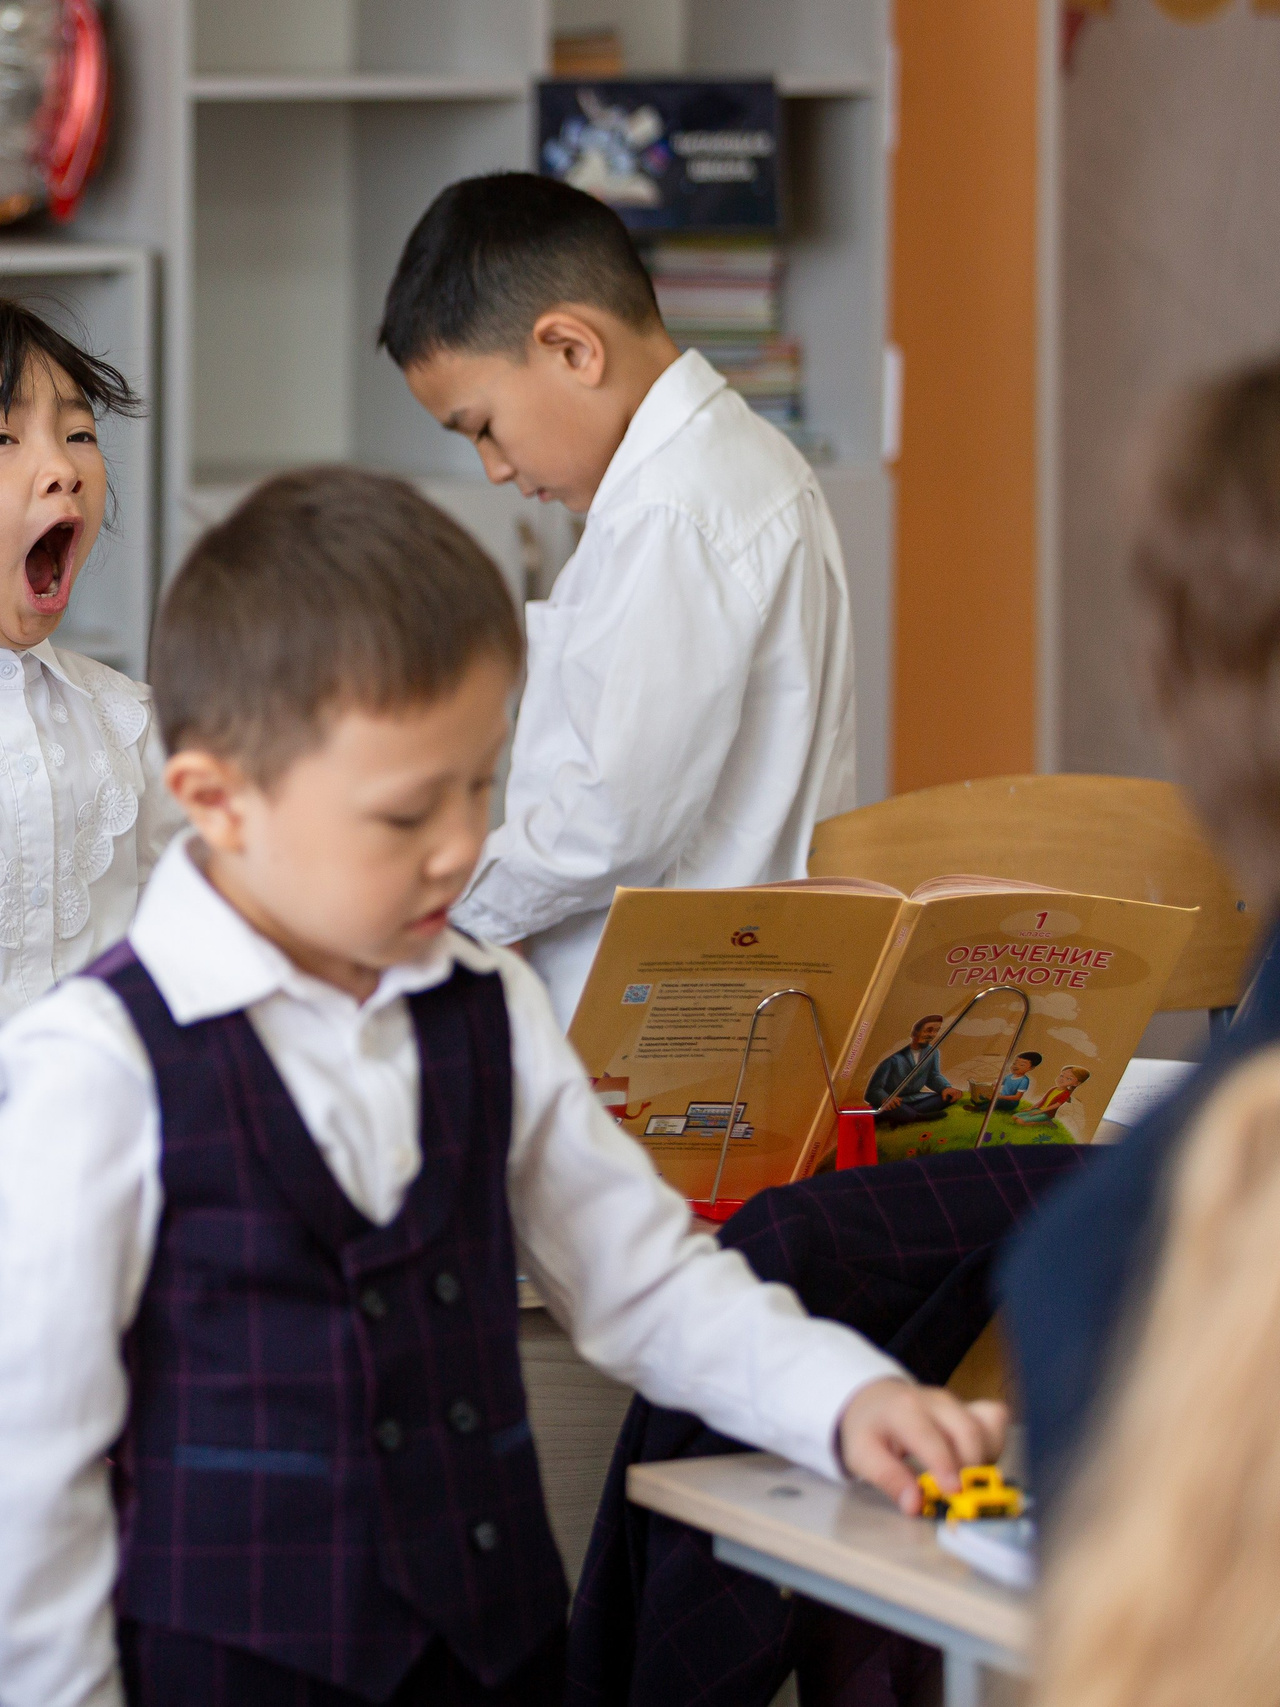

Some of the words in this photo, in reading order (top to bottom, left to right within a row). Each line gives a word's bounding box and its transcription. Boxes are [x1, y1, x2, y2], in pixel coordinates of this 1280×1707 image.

[1035, 911, 1049, 930] 1
[946, 944, 1113, 969] ОБУЧЕНИЕ
[947, 966, 1090, 989] ГРАМОТЕ
